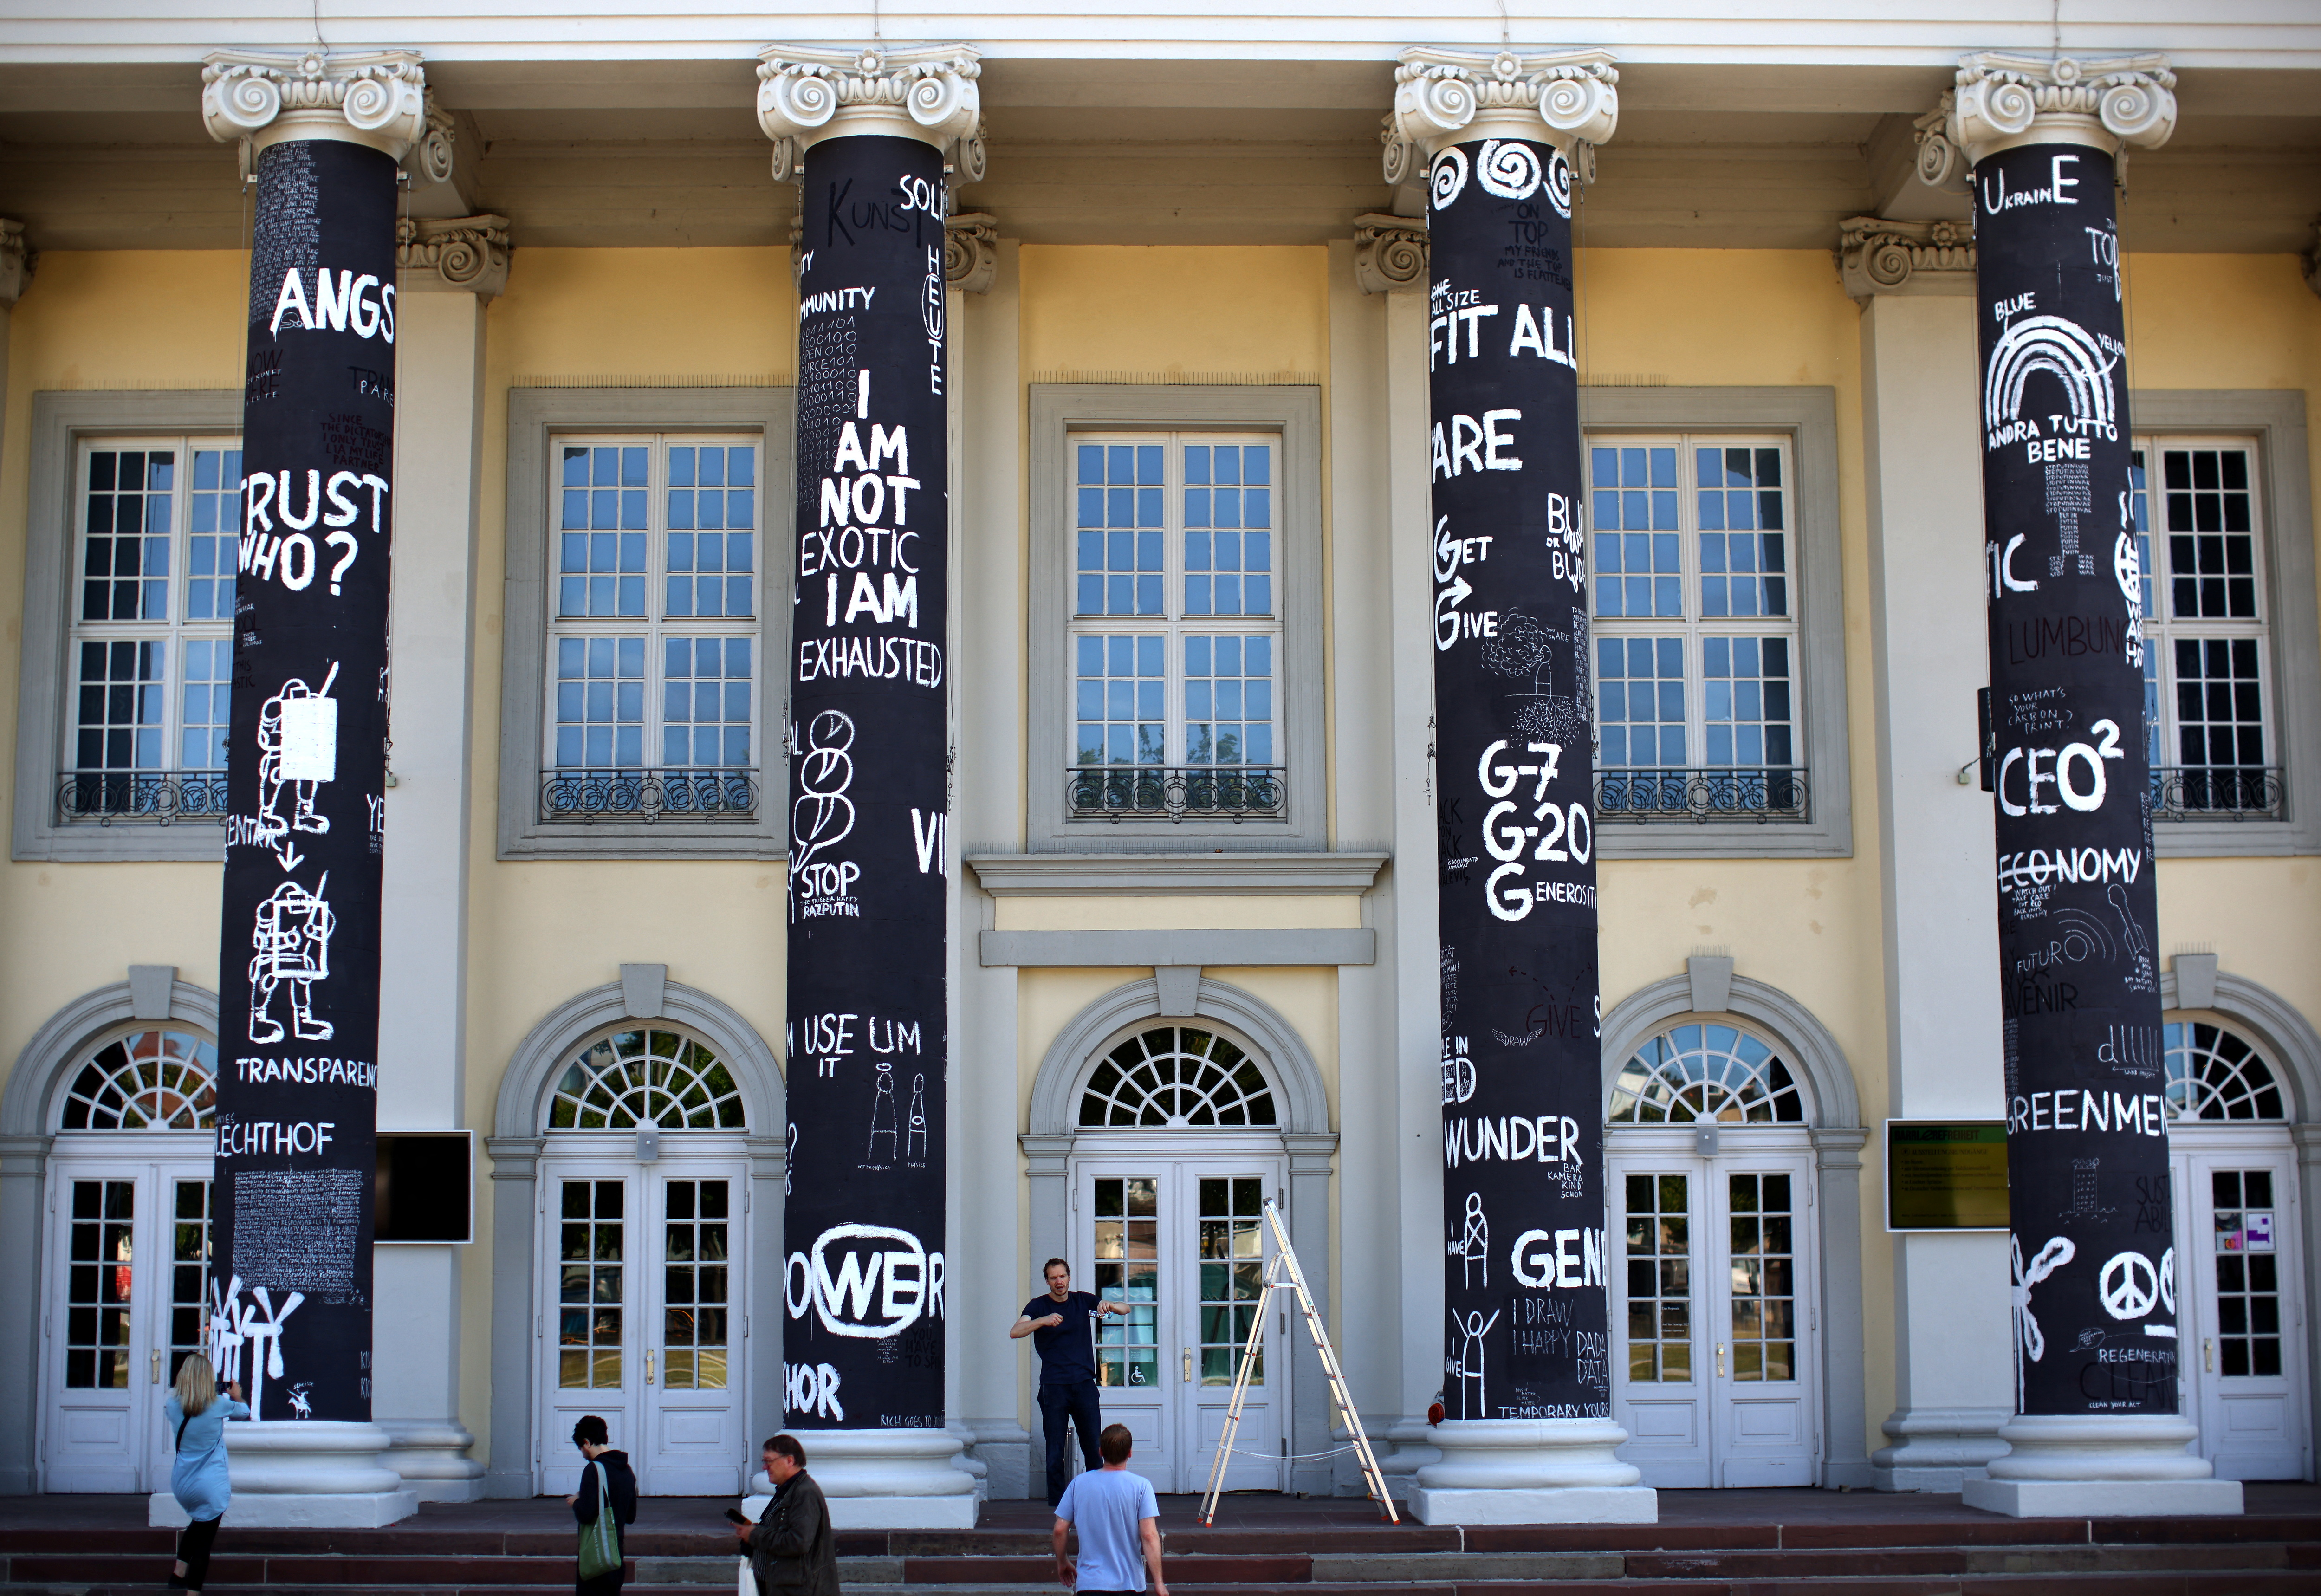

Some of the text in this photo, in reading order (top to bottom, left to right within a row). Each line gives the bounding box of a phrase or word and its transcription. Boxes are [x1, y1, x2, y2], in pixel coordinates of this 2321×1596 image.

[1984, 155, 2080, 214] UKRAINE
[1517, 203, 1539, 219] ON
[1509, 220, 1548, 247] TOP
[1505, 245, 1522, 256] MY
[1497, 258, 1562, 272] AND THE TOP
[1515, 268, 1524, 278] IS
[1447, 289, 1481, 310] SIZE
[1995, 292, 2036, 322] BLUE
[1431, 305, 1498, 372] FIT
[858, 369, 870, 419] I
[320, 423, 341, 432] THE
[329, 412, 362, 425] SINCE
[1988, 414, 2119, 452] ANDRA TUTTO
[324, 433, 384, 454] I ONLY TRUST
[834, 421, 908, 475] AM
[2027, 438, 2091, 464] BENE
[333, 454, 379, 474] PARTNER
[350, 446, 363, 456] MY
[365, 449, 383, 464] LIFE
[241, 469, 389, 534] RUST
[820, 473, 921, 527] NOT
[802, 526, 920, 577] EXOTIC
[1546, 537, 1560, 548] OR
[826, 573, 838, 627] I
[845, 572, 918, 629] AM
[1549, 631, 1571, 643] SHARE
[800, 636, 942, 688] EXHAUSTED
[2009, 686, 2066, 706] SO WHAT'S
[2009, 709, 2057, 725] CARBON
[2014, 702, 2038, 716] YOUR
[1478, 740, 1562, 802] G-7
[1482, 800, 1591, 864] G-20
[801, 861, 860, 899] STOP
[1998, 847, 2141, 893] ECONOMY
[2012, 895, 2027, 903] TAKE
[2014, 887, 2036, 896] WATCH
[804, 902, 860, 919] RAZPUTIN
[2014, 908, 2027, 916] BACK
[1526, 1004, 1581, 1038] GIVE
[1504, 1035, 1529, 1046] DRAW
[820, 1057, 842, 1077] IT
[1445, 1116, 1584, 1169] WUNDER
[1548, 1172, 1583, 1183] KAMERA
[1564, 1163, 1582, 1174] BAR
[1561, 1189, 1583, 1199] SCHÖN
[1562, 1181, 1582, 1191] KIND
[1448, 1240, 1465, 1255] HAVE
[1513, 1298, 1573, 1326] I DRAW
[1513, 1330, 1570, 1358] I HAPPY
[1577, 1331, 1606, 1360] DADA
[1446, 1360, 1462, 1378] GIVE
[1498, 1402, 1608, 1419] TEMPORARY YOURS
[905, 1415, 922, 1427] GOES
[925, 1415, 931, 1427] TO
